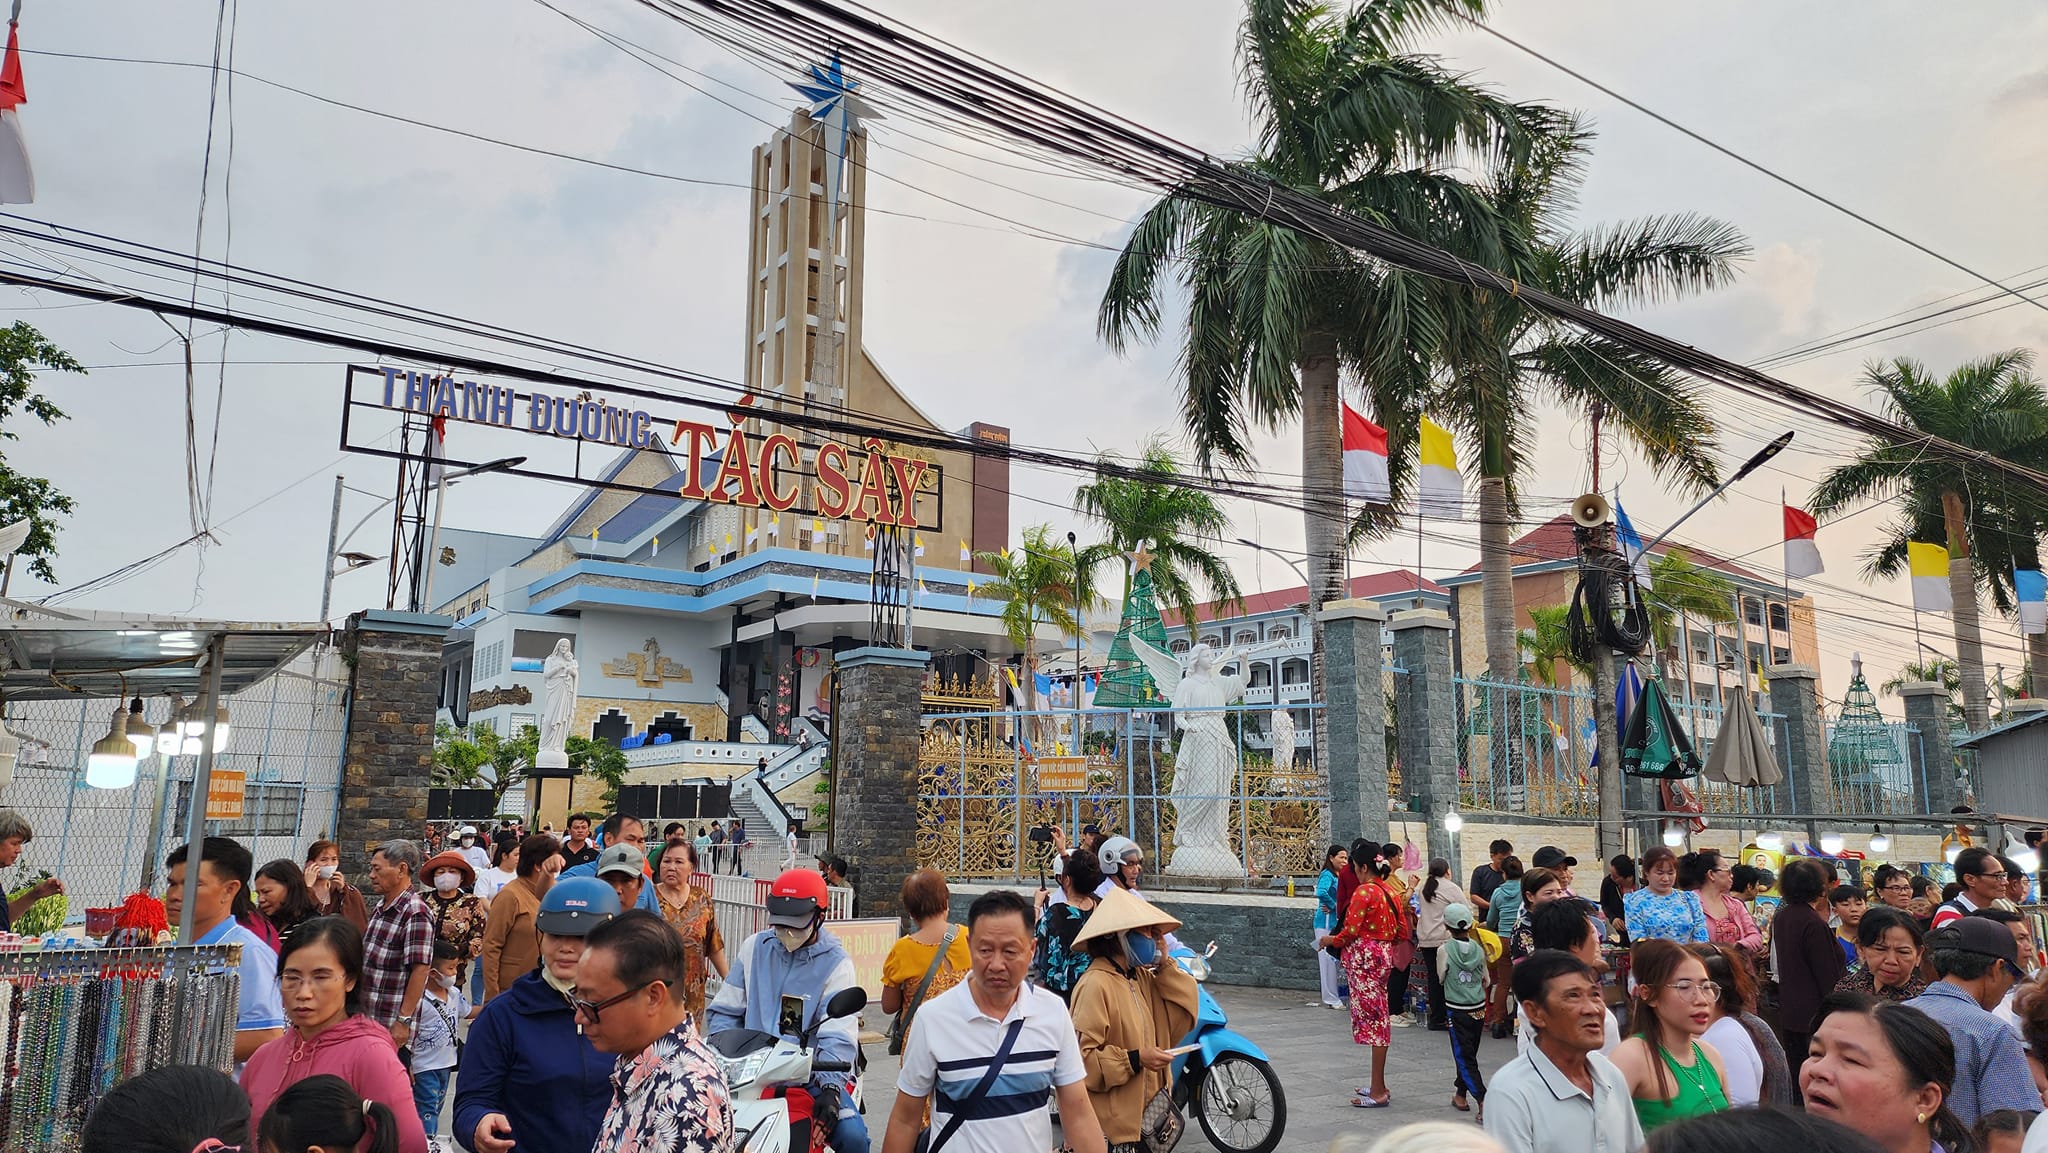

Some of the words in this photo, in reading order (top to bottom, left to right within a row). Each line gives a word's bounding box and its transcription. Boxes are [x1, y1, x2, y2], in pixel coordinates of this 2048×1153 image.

[527, 391, 652, 449] ĐƯỜNG
[816, 437, 928, 540] SẬY
[854, 928, 876, 960] ĐẬU
